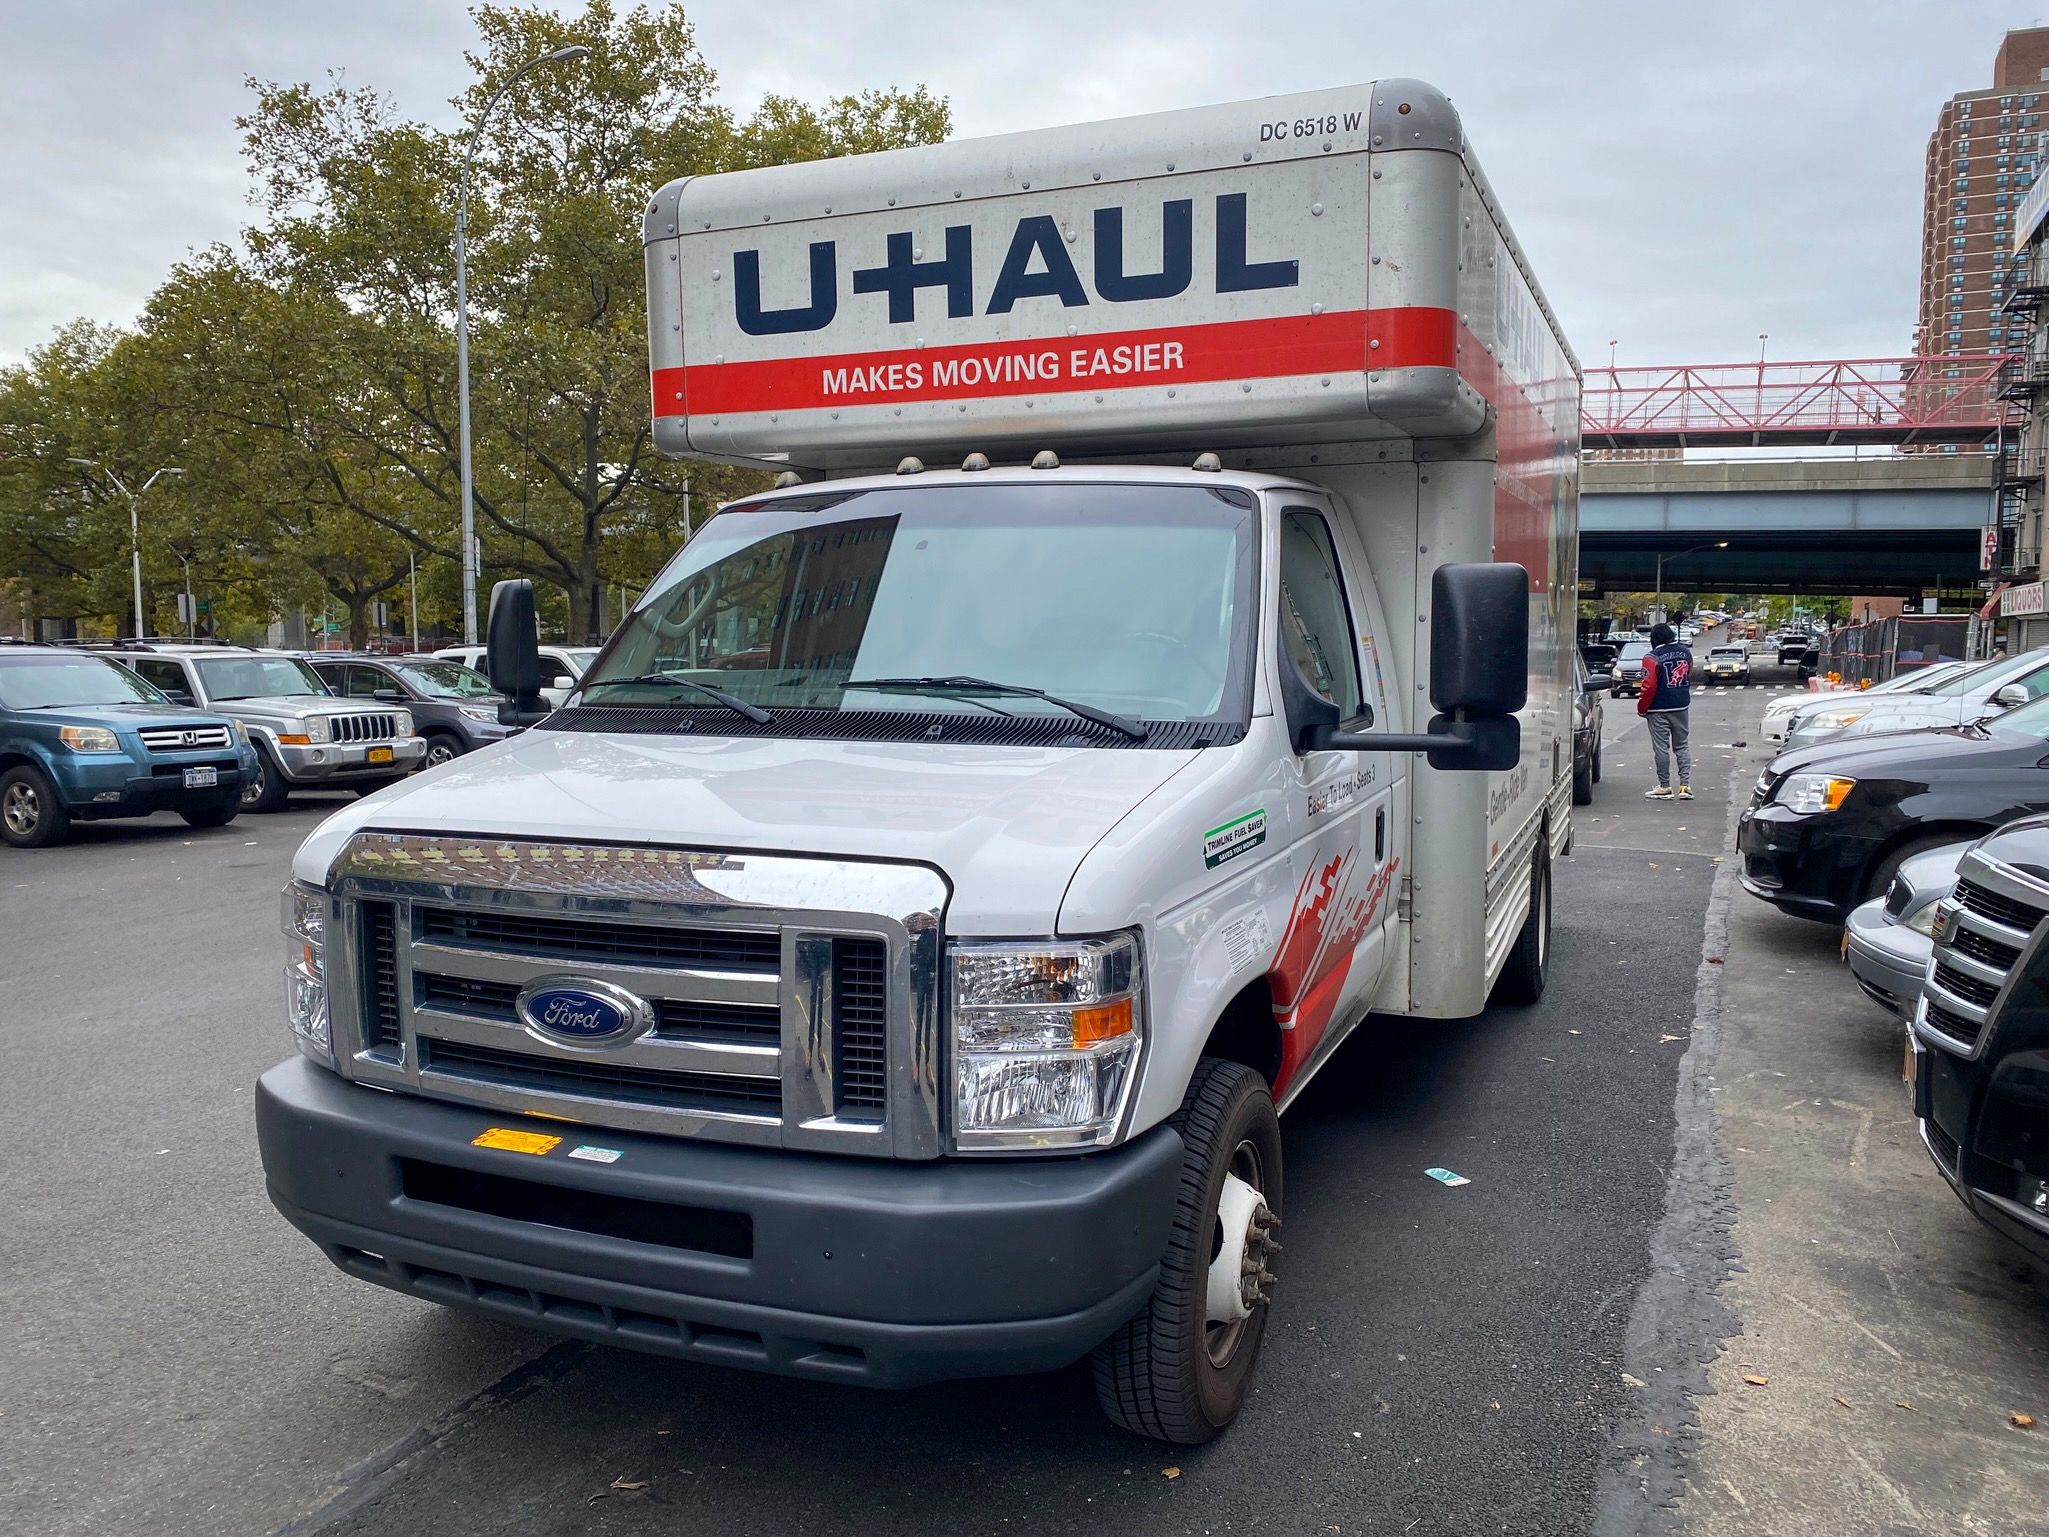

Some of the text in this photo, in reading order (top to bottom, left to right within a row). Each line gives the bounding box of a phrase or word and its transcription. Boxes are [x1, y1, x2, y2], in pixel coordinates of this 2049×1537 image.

[1260, 112, 1362, 142] DC 6518 W
[733, 192, 1299, 336] U-HAUL
[822, 342, 1185, 395] MAKES MOVING EASIER
[2010, 587, 2042, 612] LIQUORS
[1308, 763, 1375, 817] Easier To Load Seats 3
[1207, 818, 1264, 852] TRIMLINE FUEL SAVER
[1218, 837, 1257, 862] SAVES YOU MONEY
[544, 997, 601, 1029] Ford
